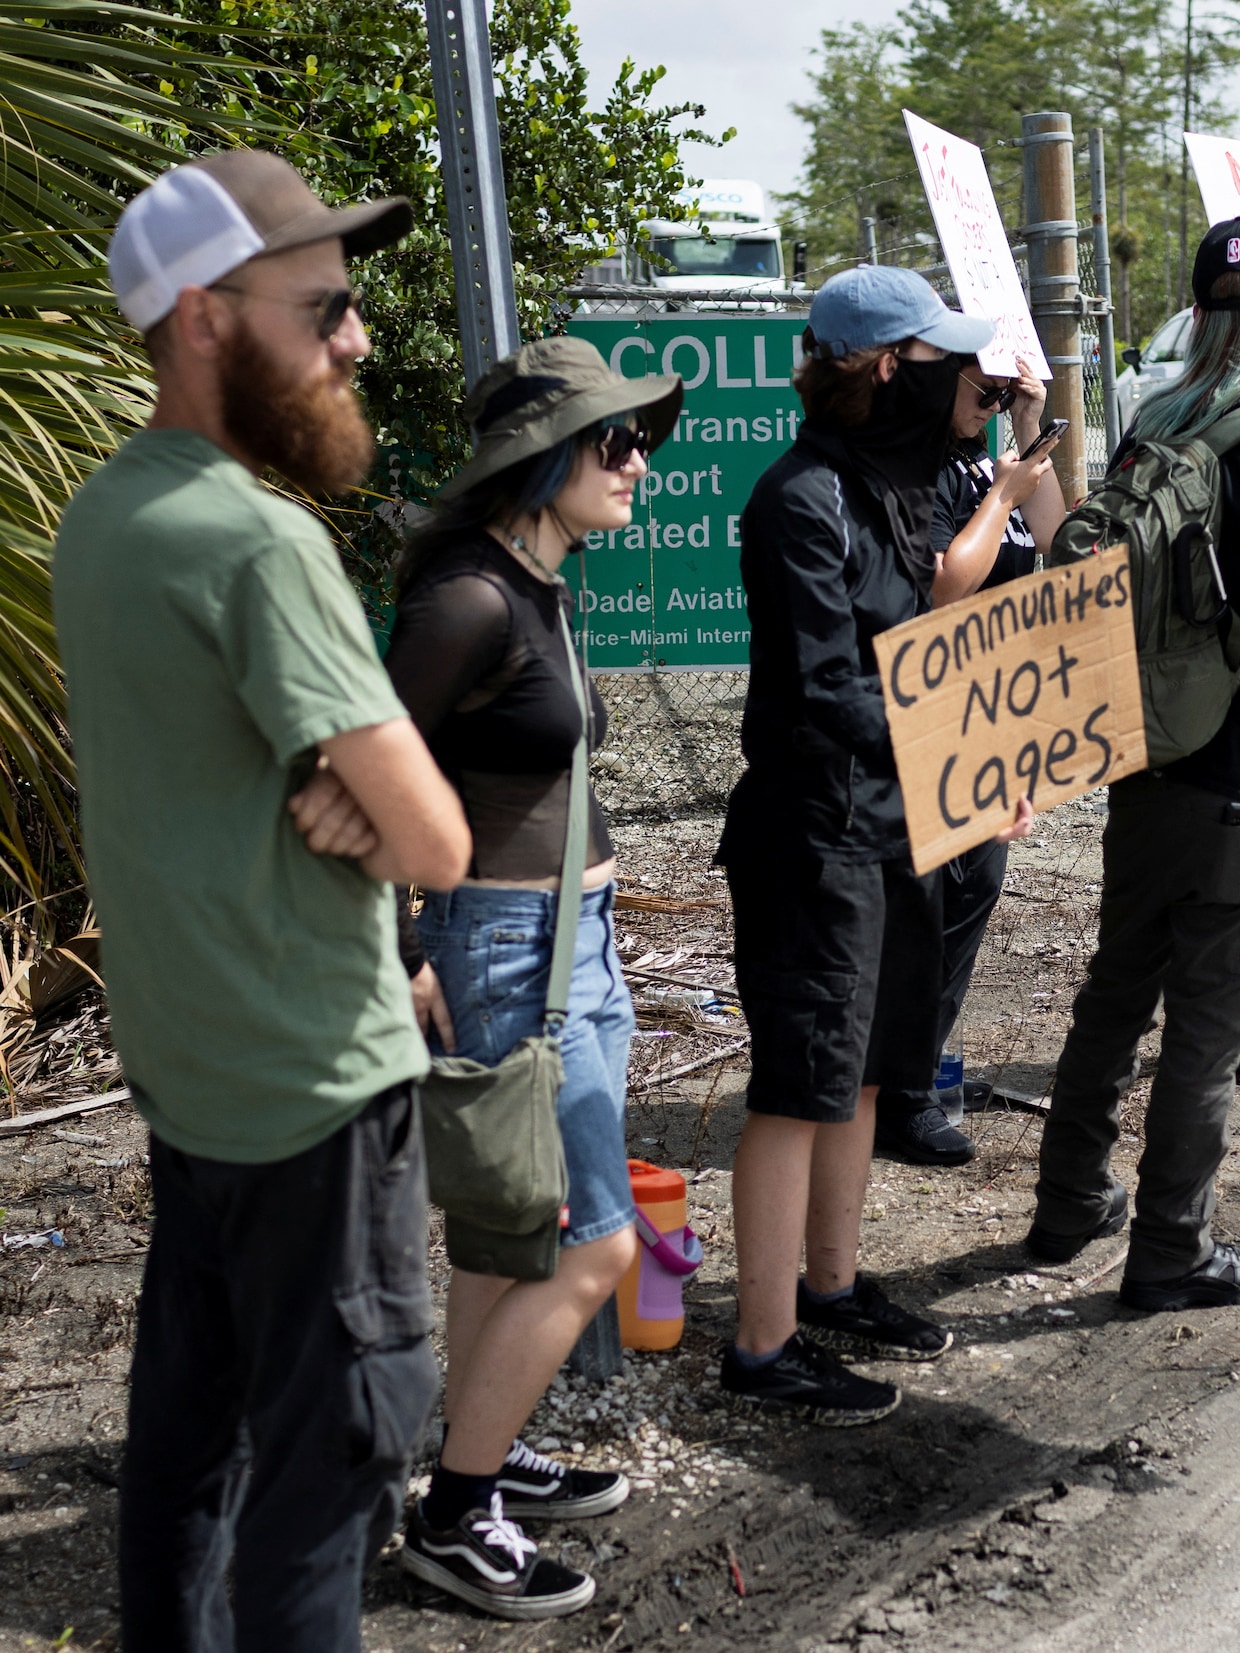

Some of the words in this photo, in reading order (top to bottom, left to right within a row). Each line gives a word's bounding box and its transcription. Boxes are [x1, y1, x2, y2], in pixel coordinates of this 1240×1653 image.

[610, 334, 805, 389] COLLI
[673, 408, 806, 442] Transit
[640, 464, 723, 505] port
[582, 515, 709, 550] erated
[575, 589, 651, 613] Dade
[574, 628, 688, 646] ffice-Miami
[697, 628, 752, 643] Intern
